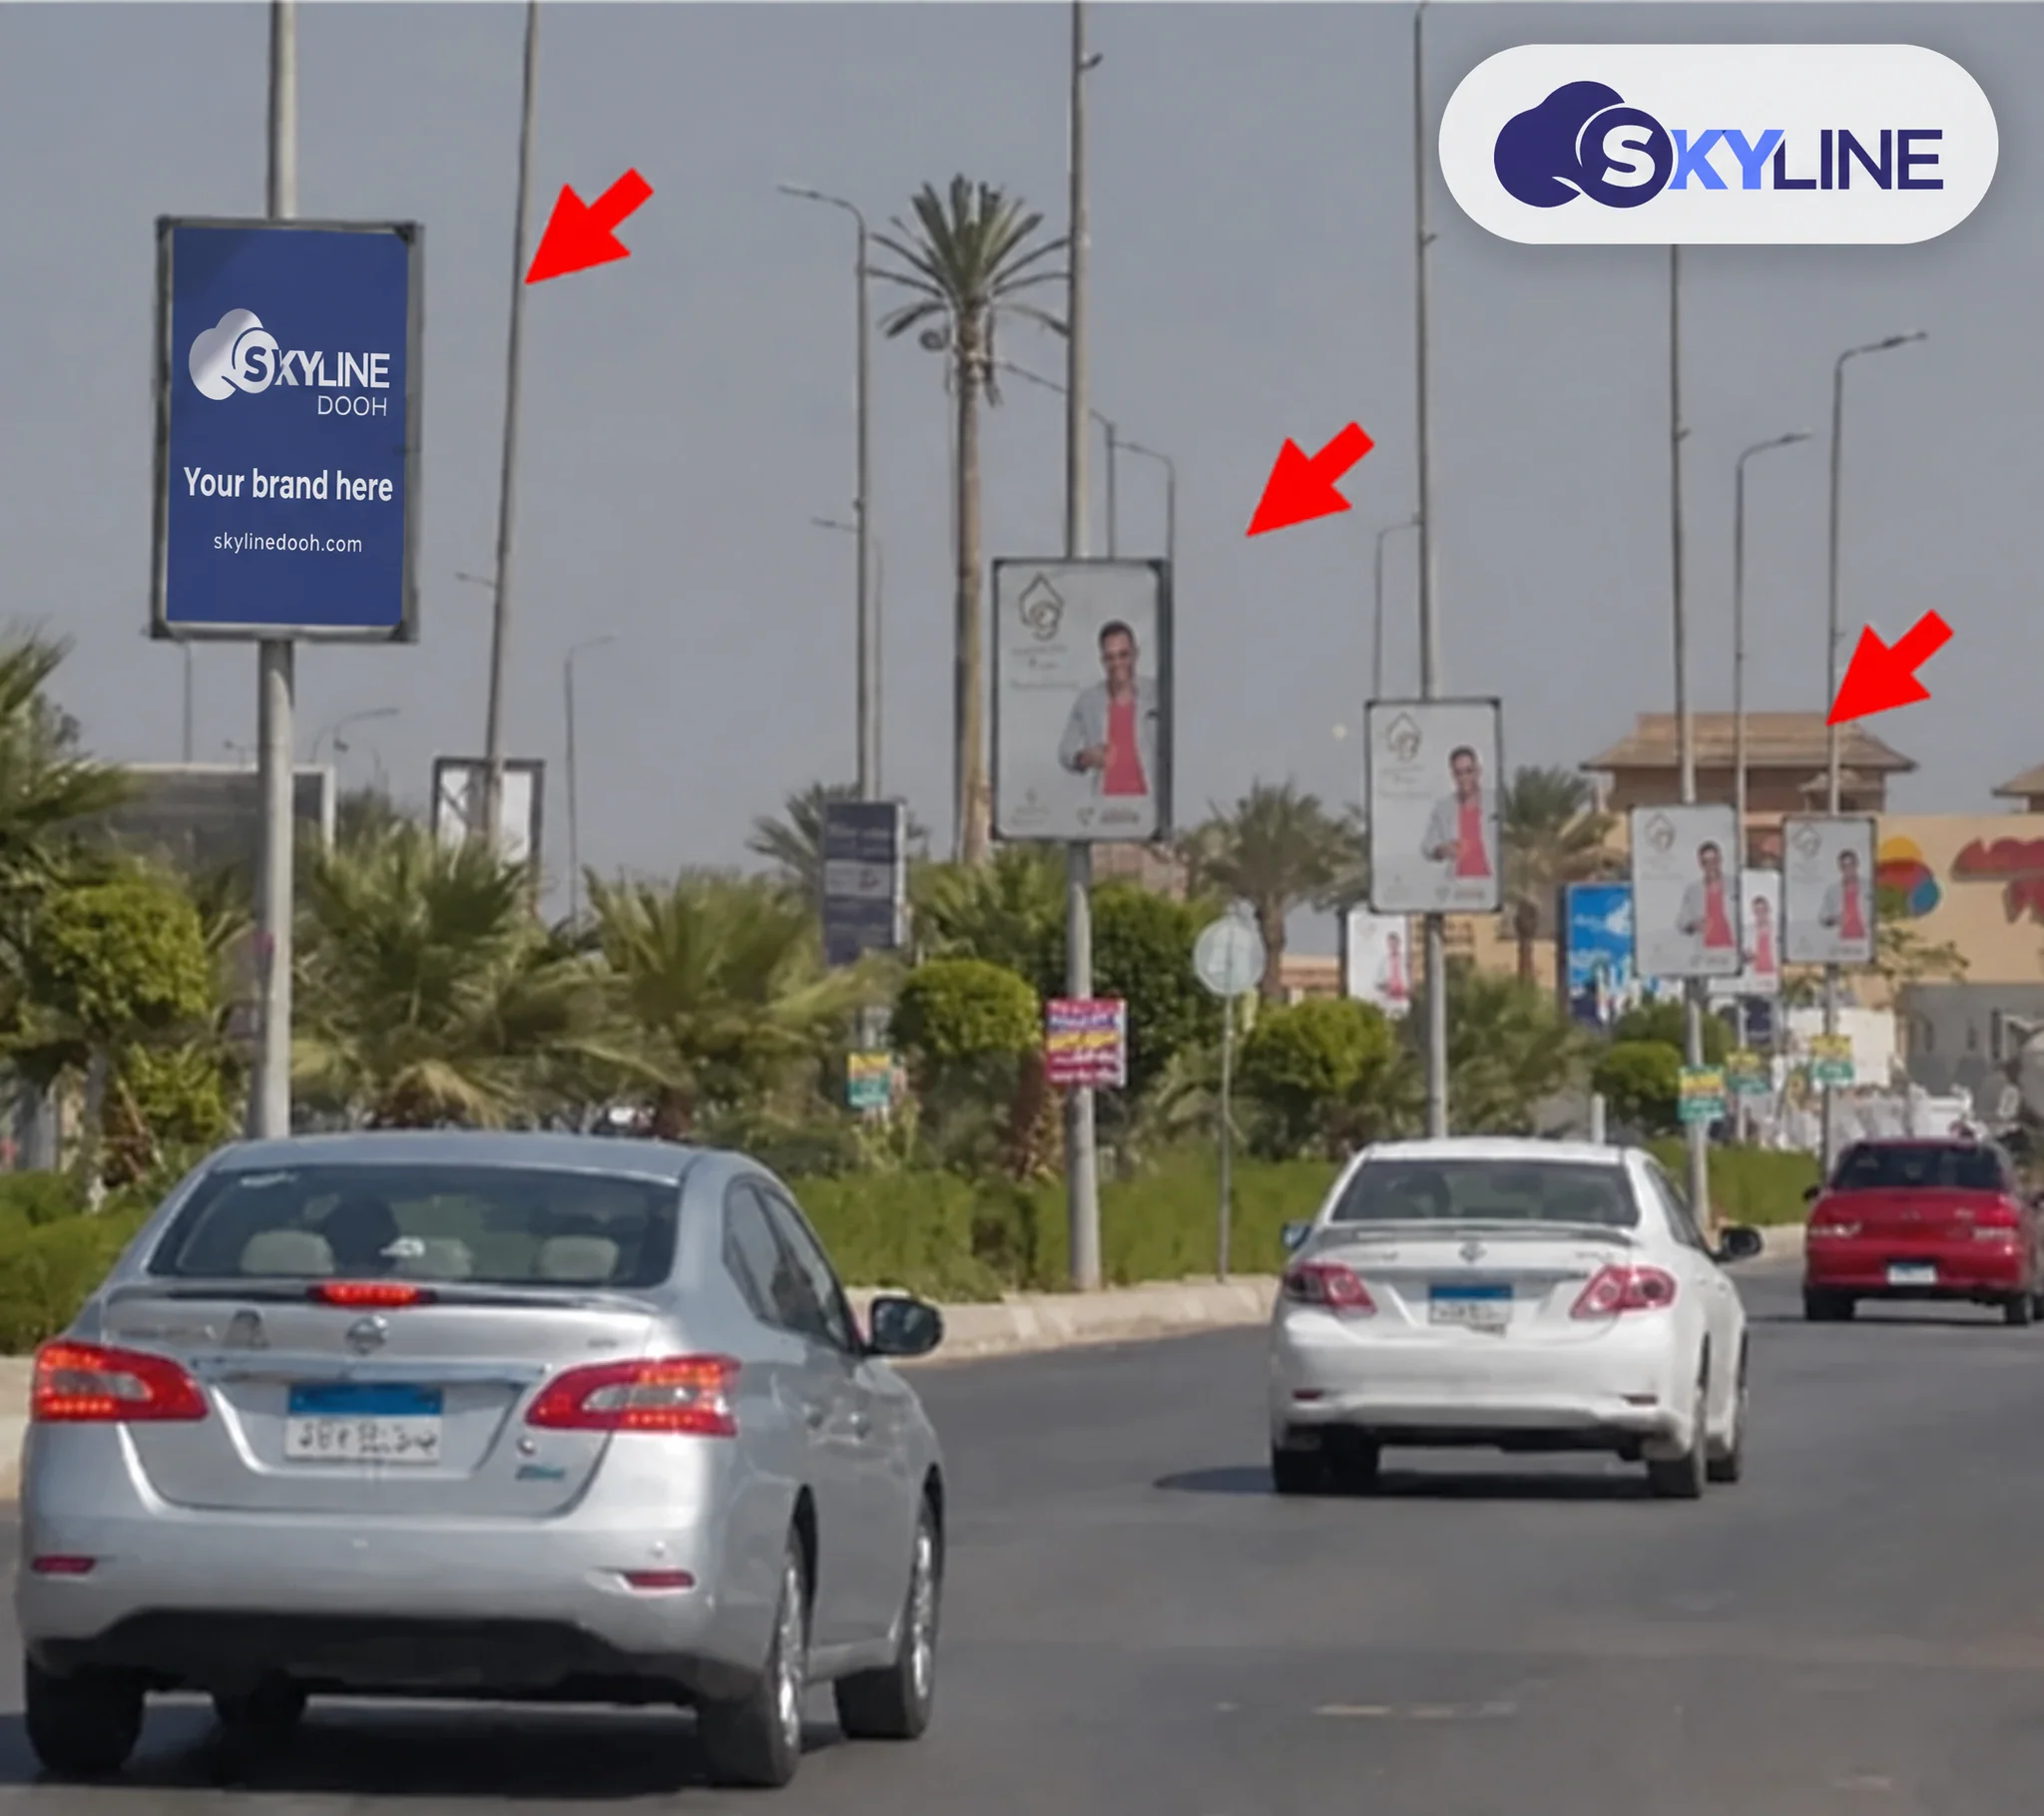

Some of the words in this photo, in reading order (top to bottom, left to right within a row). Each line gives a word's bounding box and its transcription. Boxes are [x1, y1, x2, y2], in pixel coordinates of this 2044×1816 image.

[244, 345, 390, 389] SKYLINE
[317, 394, 387, 417] DOOH
[184, 466, 246, 498] Your
[252, 467, 328, 501] brand
[336, 469, 393, 502] here
[214, 531, 362, 555] skylinedooh.com
